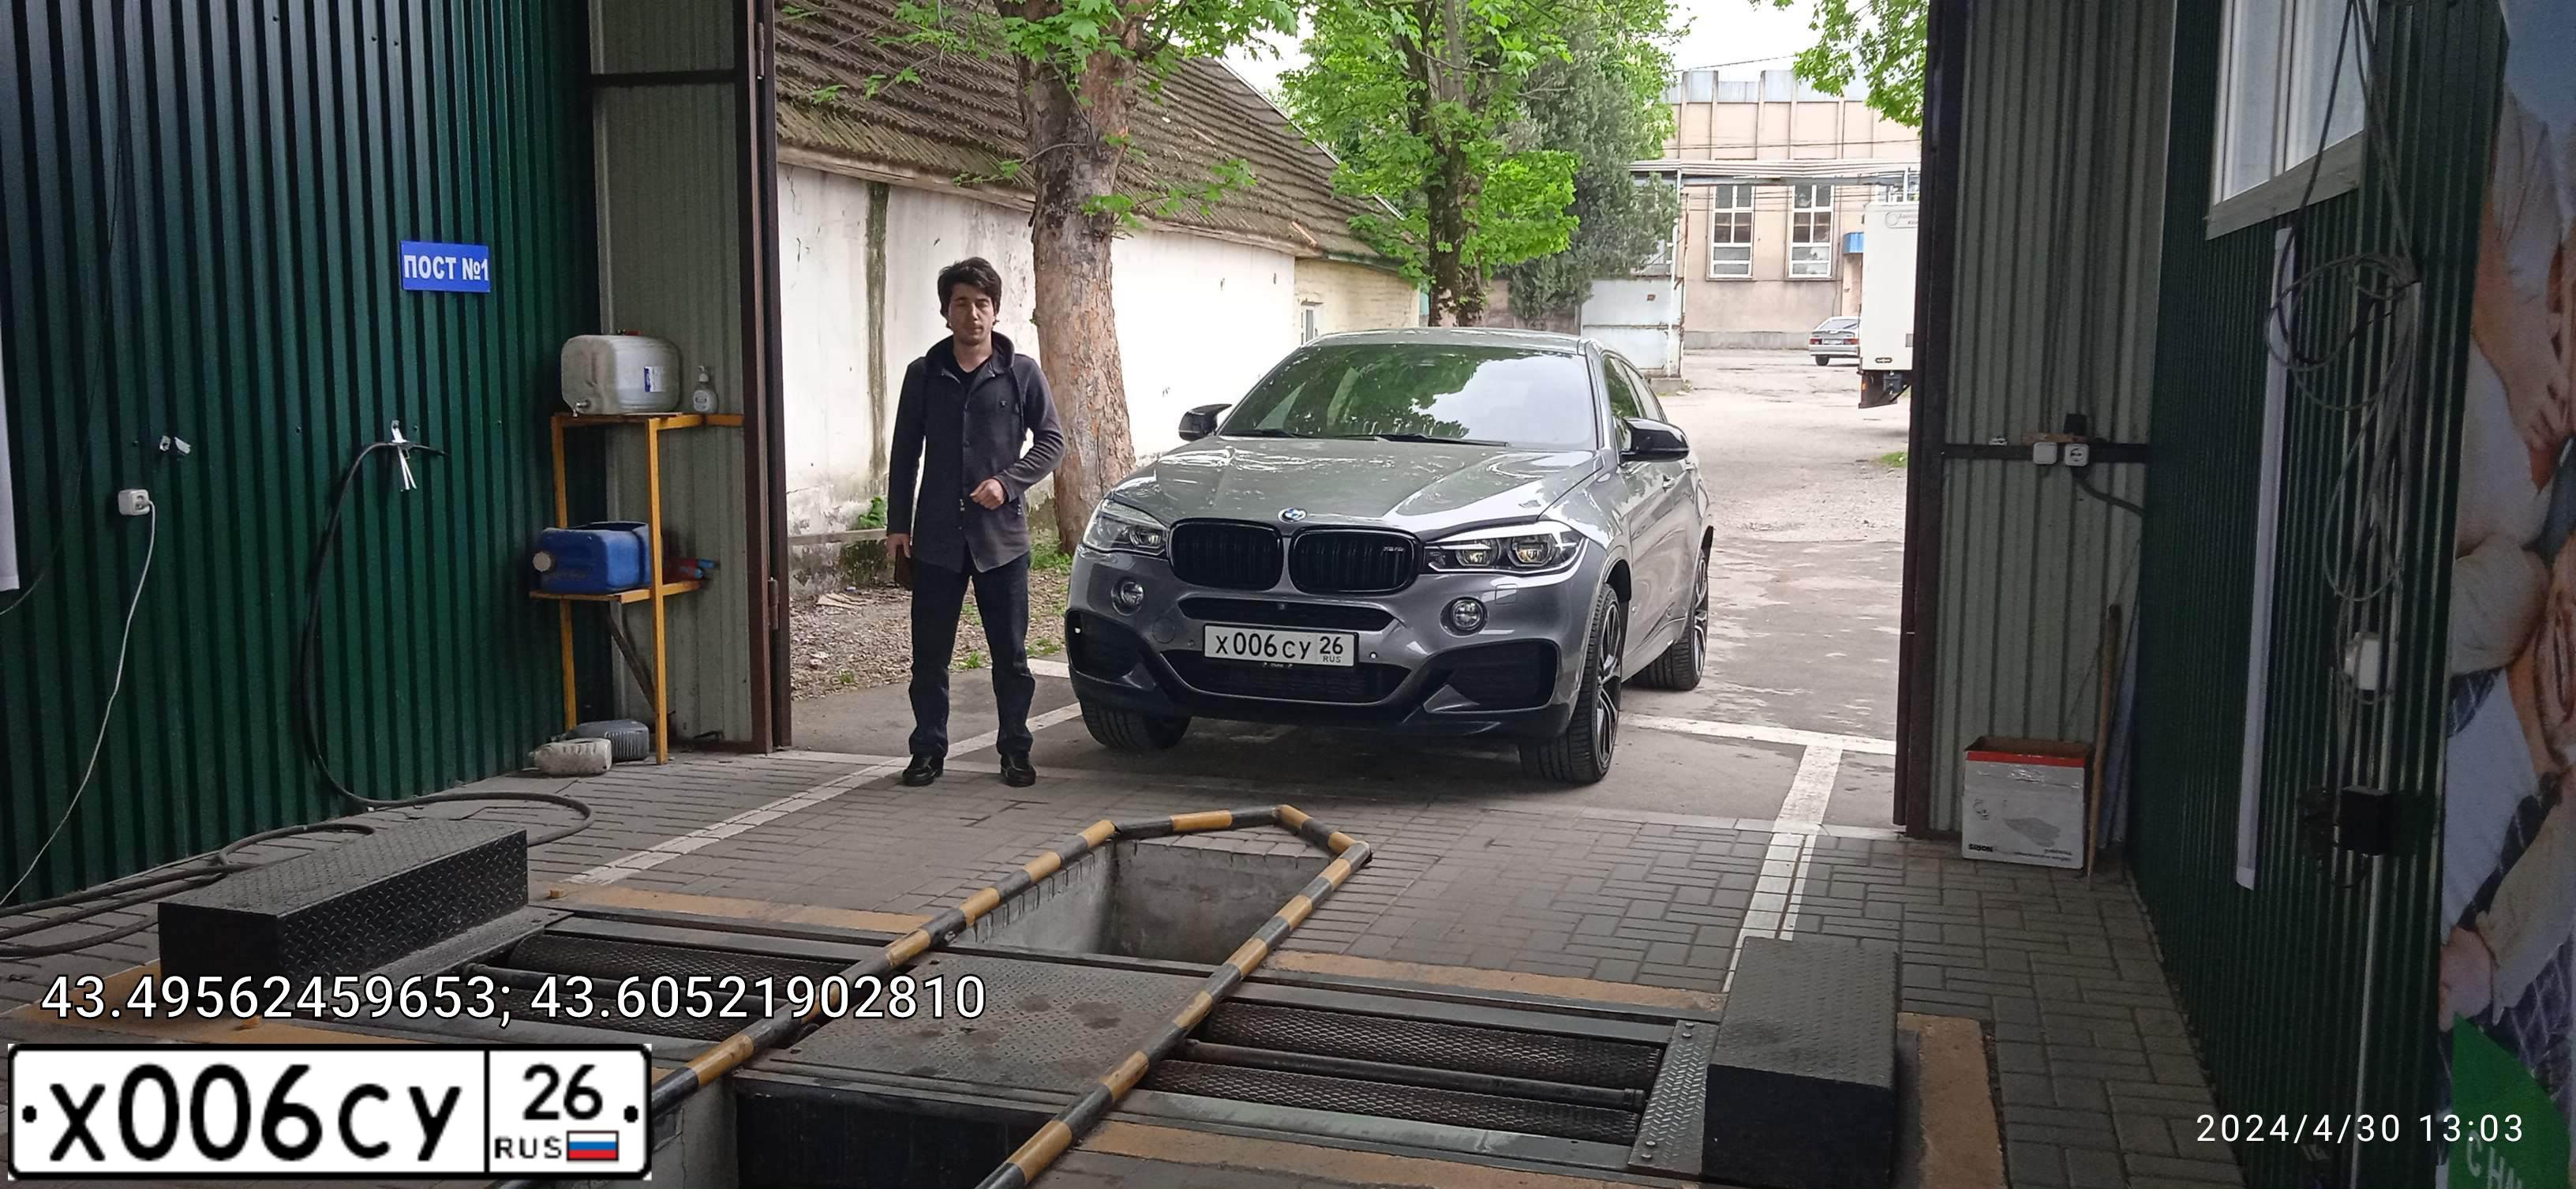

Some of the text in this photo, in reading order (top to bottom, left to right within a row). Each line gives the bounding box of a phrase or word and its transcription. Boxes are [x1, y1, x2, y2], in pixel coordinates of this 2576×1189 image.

[403, 254, 489, 281] ПОСТ №1
[1320, 636, 1343, 655] 26
